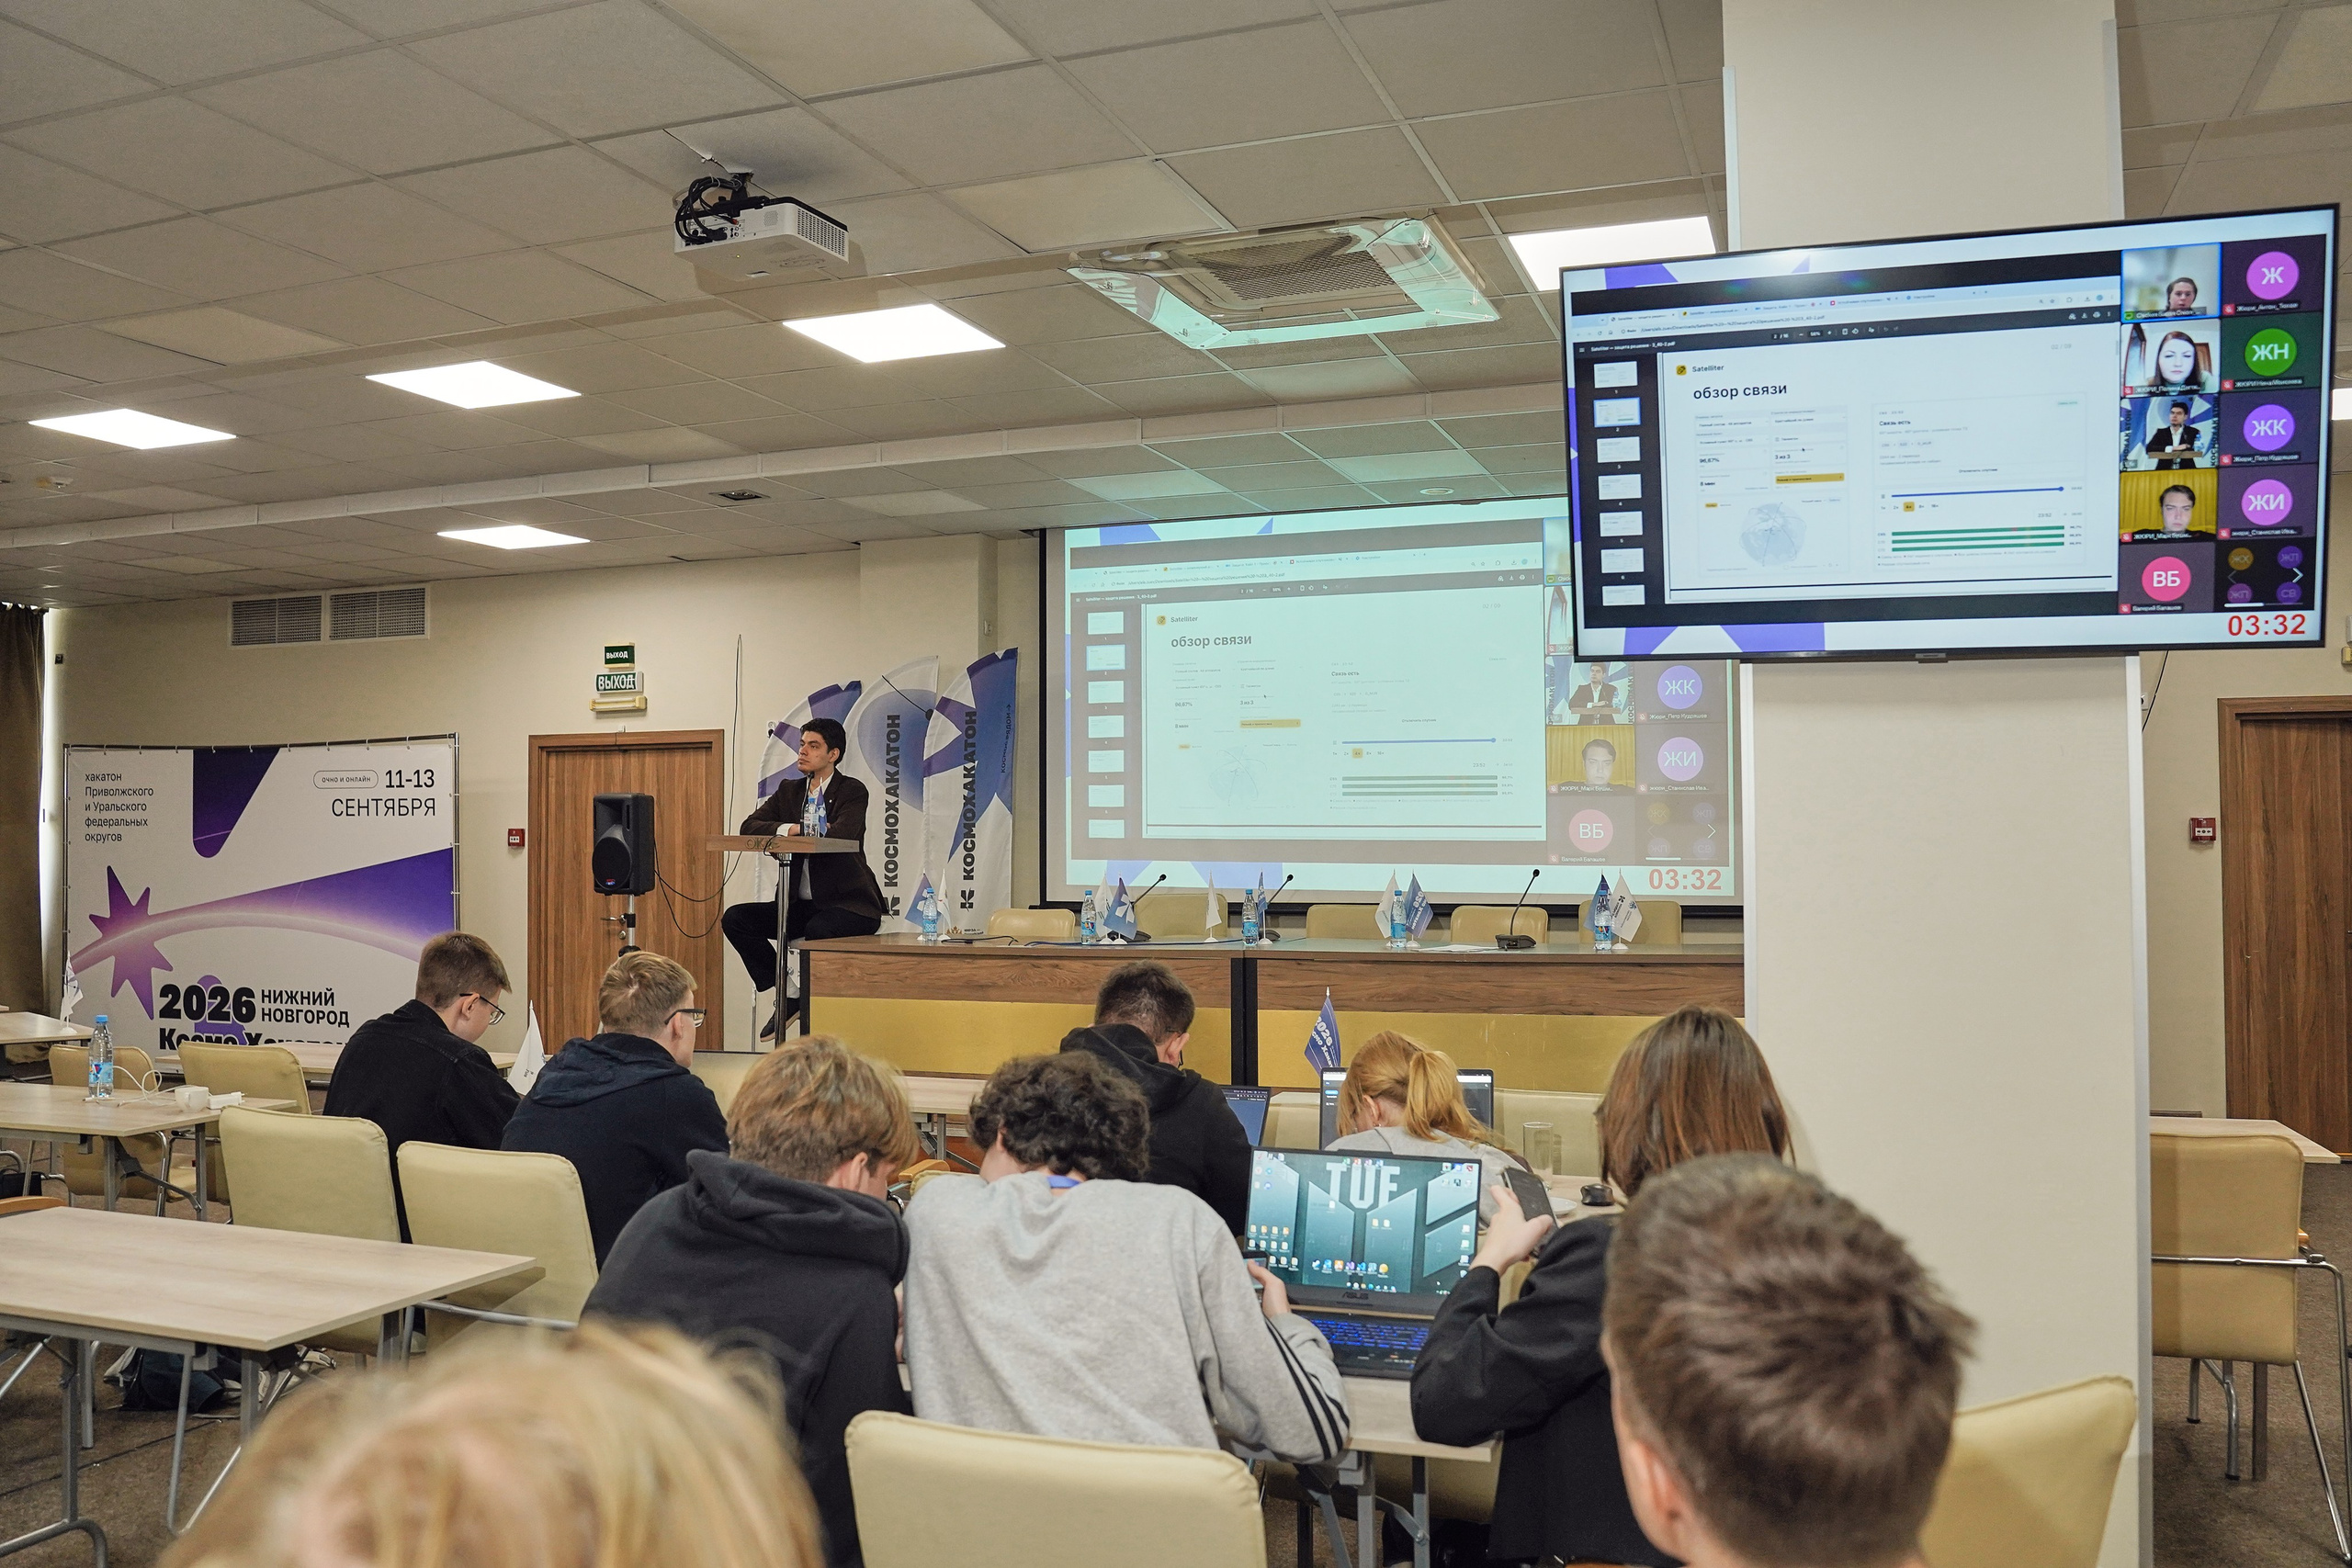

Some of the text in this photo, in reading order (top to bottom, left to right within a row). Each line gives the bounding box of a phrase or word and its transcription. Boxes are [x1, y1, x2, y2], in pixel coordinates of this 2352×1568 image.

[2261, 266, 2285, 285] Ж
[2252, 344, 2289, 362] ЖН
[1692, 365, 1724, 373] Satelliter
[1693, 384, 1787, 400] обзор связи
[2252, 419, 2287, 437] ЖК
[2248, 493, 2285, 512] ЖИ
[2153, 570, 2181, 588] ВБ
[2228, 614, 2306, 637] 03:32
[1170, 636, 1252, 649] обзор связи
[598, 674, 635, 691] ВЫХОД
[1665, 679, 1696, 695] ЖК
[1664, 750, 1697, 767] ЖИ
[85, 773, 122, 782] хакатон
[385, 769, 435, 788] 11-13
[85, 785, 154, 797] Приволжского
[963, 711, 977, 880] КОСМОХАКАТОН
[85, 801, 147, 815] и Уральского
[332, 797, 436, 817] СЕНТЯБРЯ
[884, 714, 900, 887] КОСМОХАКАТОН
[85, 816, 149, 829] федеральных
[1578, 823, 1604, 839] ВБ
[85, 831, 122, 843] округов
[1648, 868, 1722, 891] 03:32
[159, 984, 256, 1023] 2026
[261, 987, 334, 1007] НИЖНИЙ
[261, 1008, 350, 1028] НОВГОРОД
[1326, 1162, 1400, 1209] TUF
